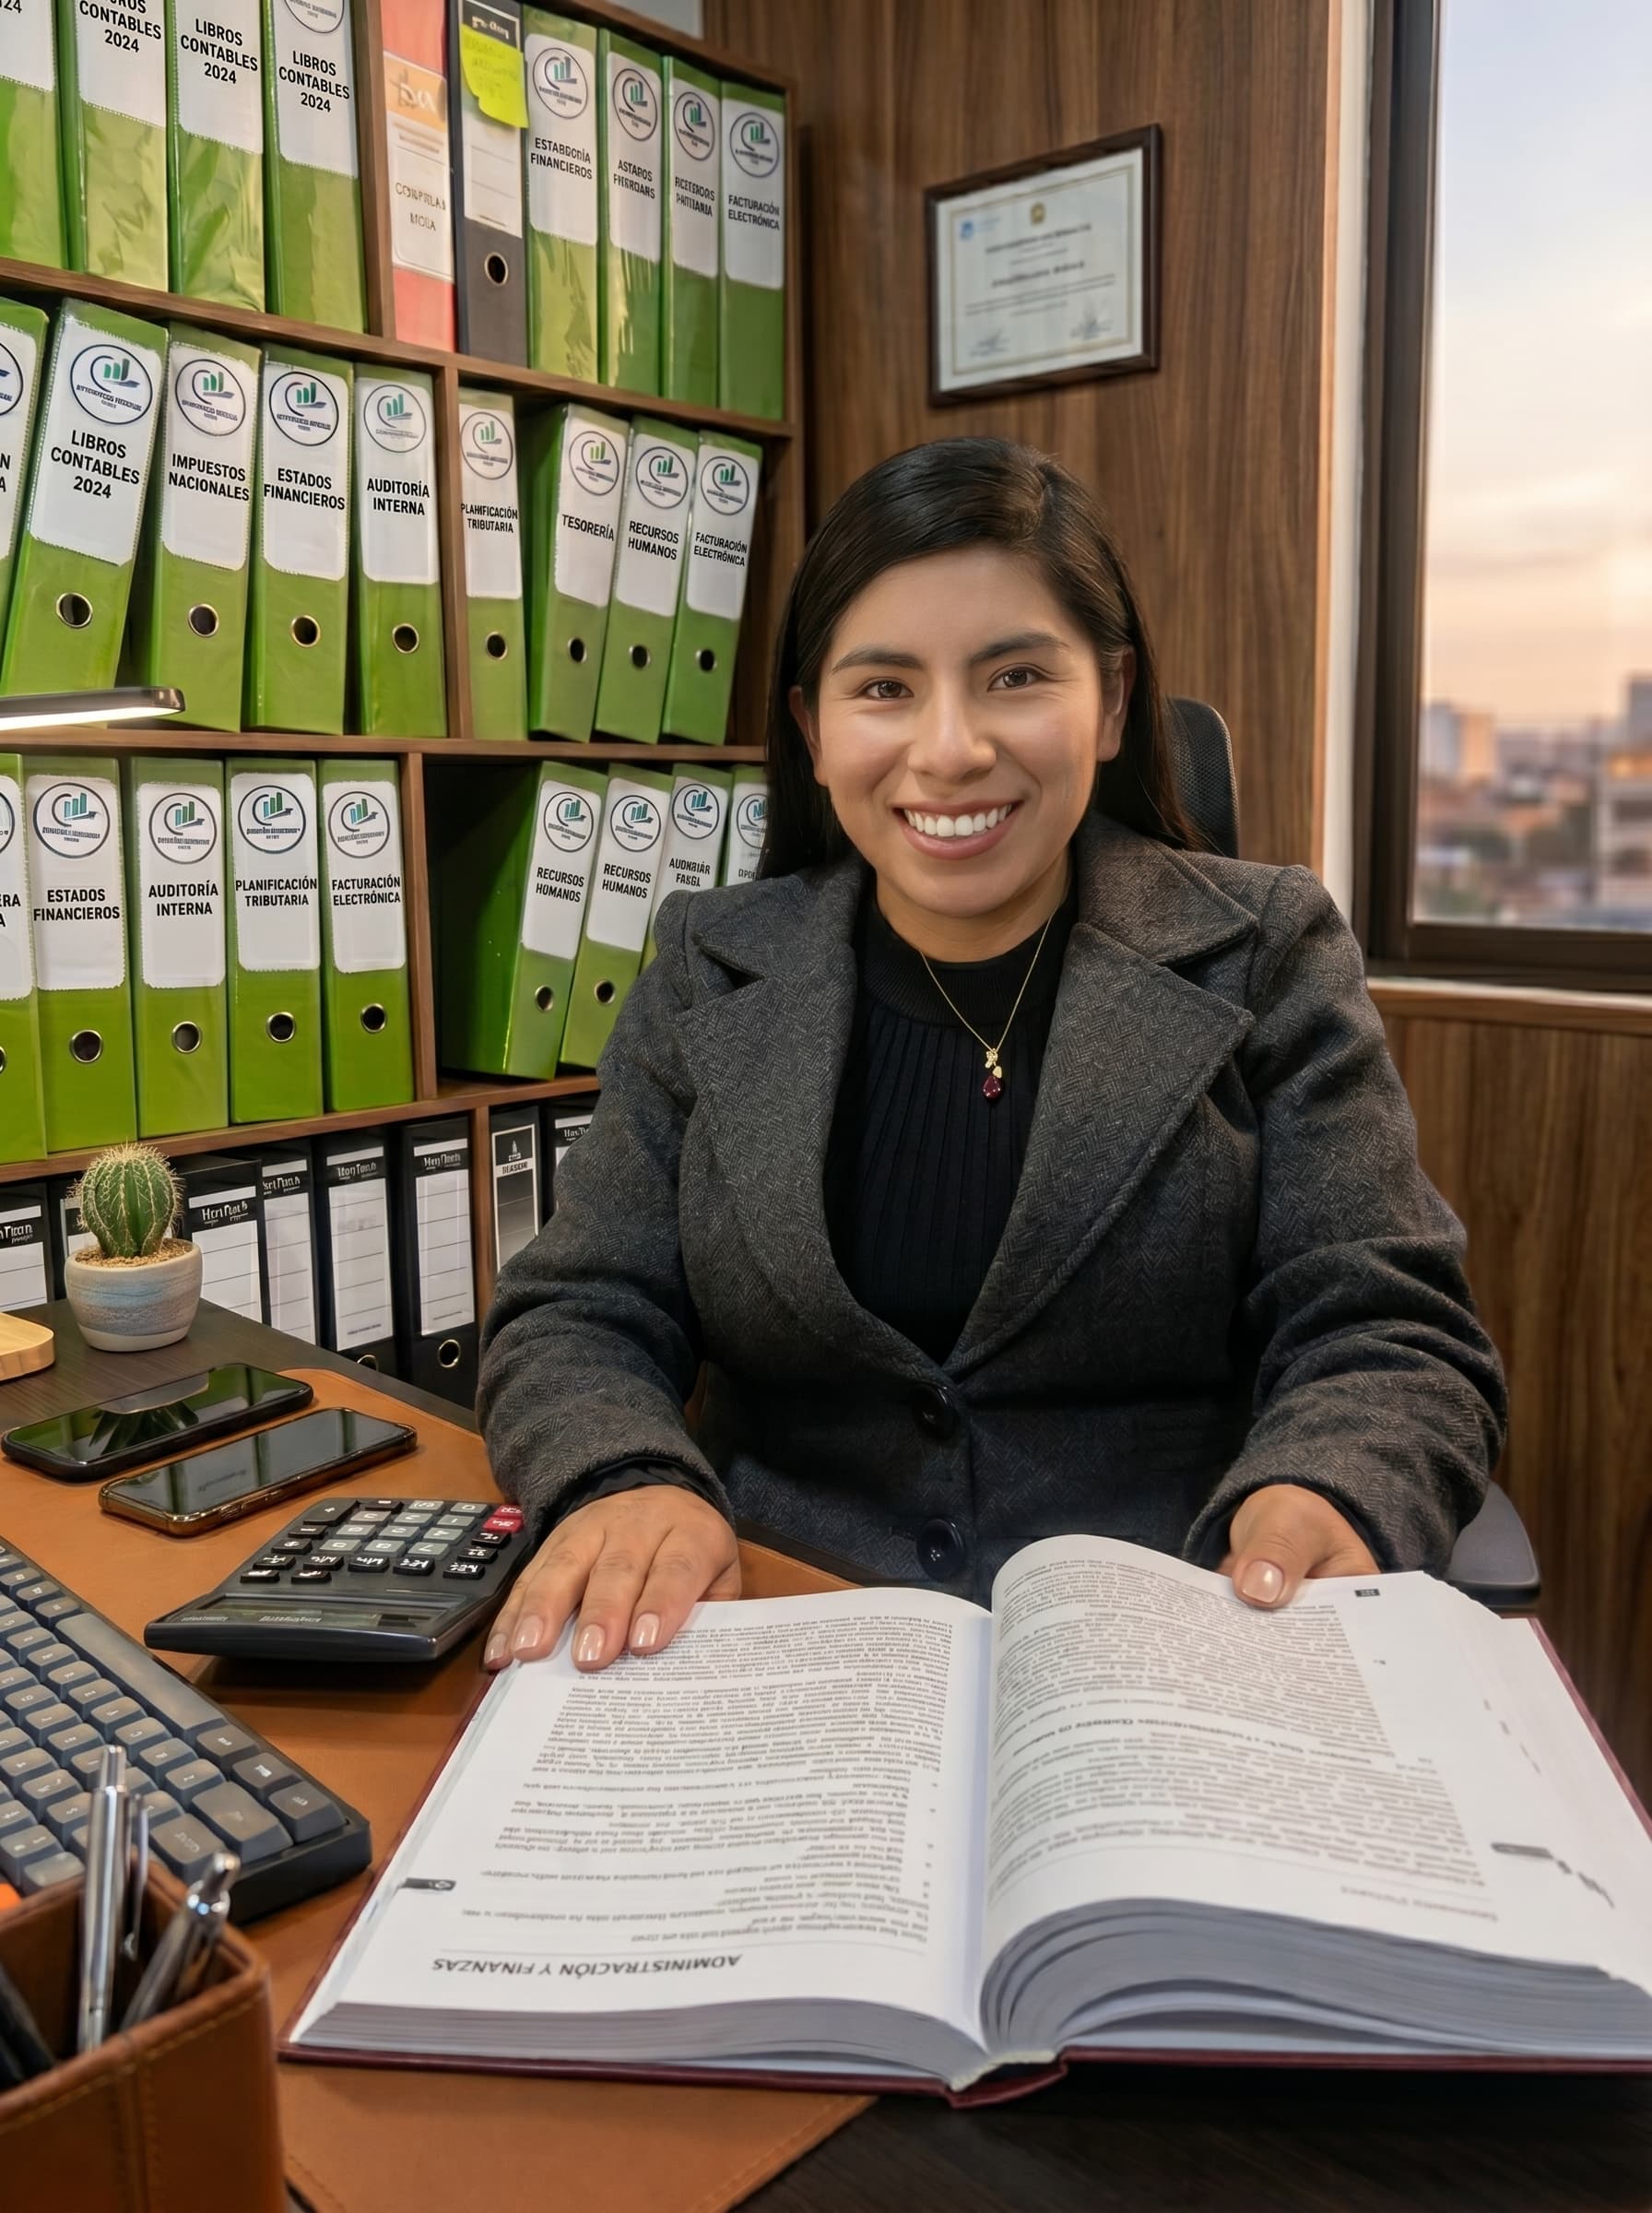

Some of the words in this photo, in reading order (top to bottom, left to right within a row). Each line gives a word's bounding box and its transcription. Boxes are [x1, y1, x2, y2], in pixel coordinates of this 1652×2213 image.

[79, 0, 161, 40] CONTABLES
[104, 29, 140, 53] 2024
[195, 18, 243, 46] LIBROS
[180, 34, 258, 72] CONTABLES
[292, 50, 336, 77] LIBROS
[204, 62, 237, 84] 2024
[278, 66, 350, 100] CONTABLES
[301, 92, 332, 112] 2024
[530, 152, 593, 180] FINANCIEROS
[728, 208, 780, 231] ELECTRÓNICA
[71, 430, 126, 458] LIBROS
[51, 446, 140, 484] CONTABLES
[171, 453, 246, 481] IMPUESTOS
[73, 476, 112, 499] 2024
[169, 471, 250, 502] NACIONALES
[277, 467, 332, 490] ESTADOS
[367, 477, 430, 498] AUDITORÍA
[264, 483, 346, 511] FINANCIEROS
[373, 497, 425, 515] INTERNA
[467, 518, 514, 533] TRIBUTARIA
[561, 514, 615, 542] TESORERÍA
[629, 520, 679, 544] RECURSOS
[628, 537, 678, 561] HUMANOS
[235, 874, 317, 892] PLANIFICACIÓN
[332, 873, 401, 892] FACTURACIÓN
[537, 867, 584, 887] RECURSOS
[603, 863, 651, 883] RECURSOS
[47, 888, 106, 903] ESTADOS
[148, 879, 218, 899] AUDITORÍA
[245, 893, 309, 907] TRIBUTARIA
[333, 890, 401, 906] ELECTRÓNICA
[602, 879, 648, 899] HUMANOS
[33, 905, 121, 921] FINANCIEROS
[156, 902, 213, 917] INTERNA
[431, 1958, 534, 1975] FINANZAS
[538, 1961, 552, 1976] Y
[558, 1954, 742, 1980] ADMINISTRACIÓN
